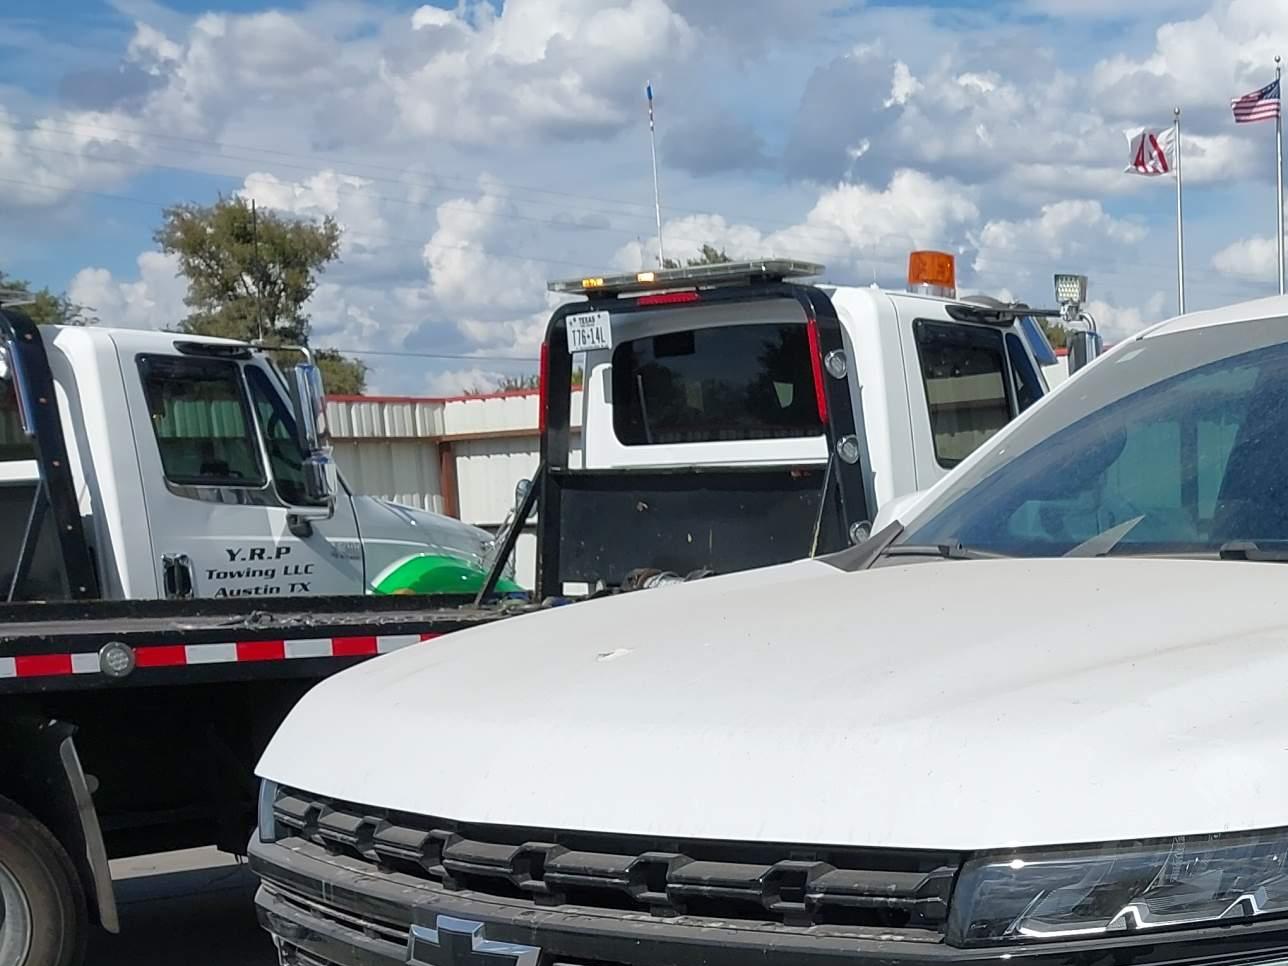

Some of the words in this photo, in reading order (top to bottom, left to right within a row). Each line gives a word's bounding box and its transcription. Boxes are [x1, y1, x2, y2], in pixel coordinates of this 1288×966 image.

[579, 315, 595, 324] TEXAS
[226, 546, 291, 562] Y.R.P
[206, 568, 276, 580] Towing
[283, 564, 314, 576] LLC
[214, 584, 280, 598] Austin
[288, 582, 312, 593] TX
